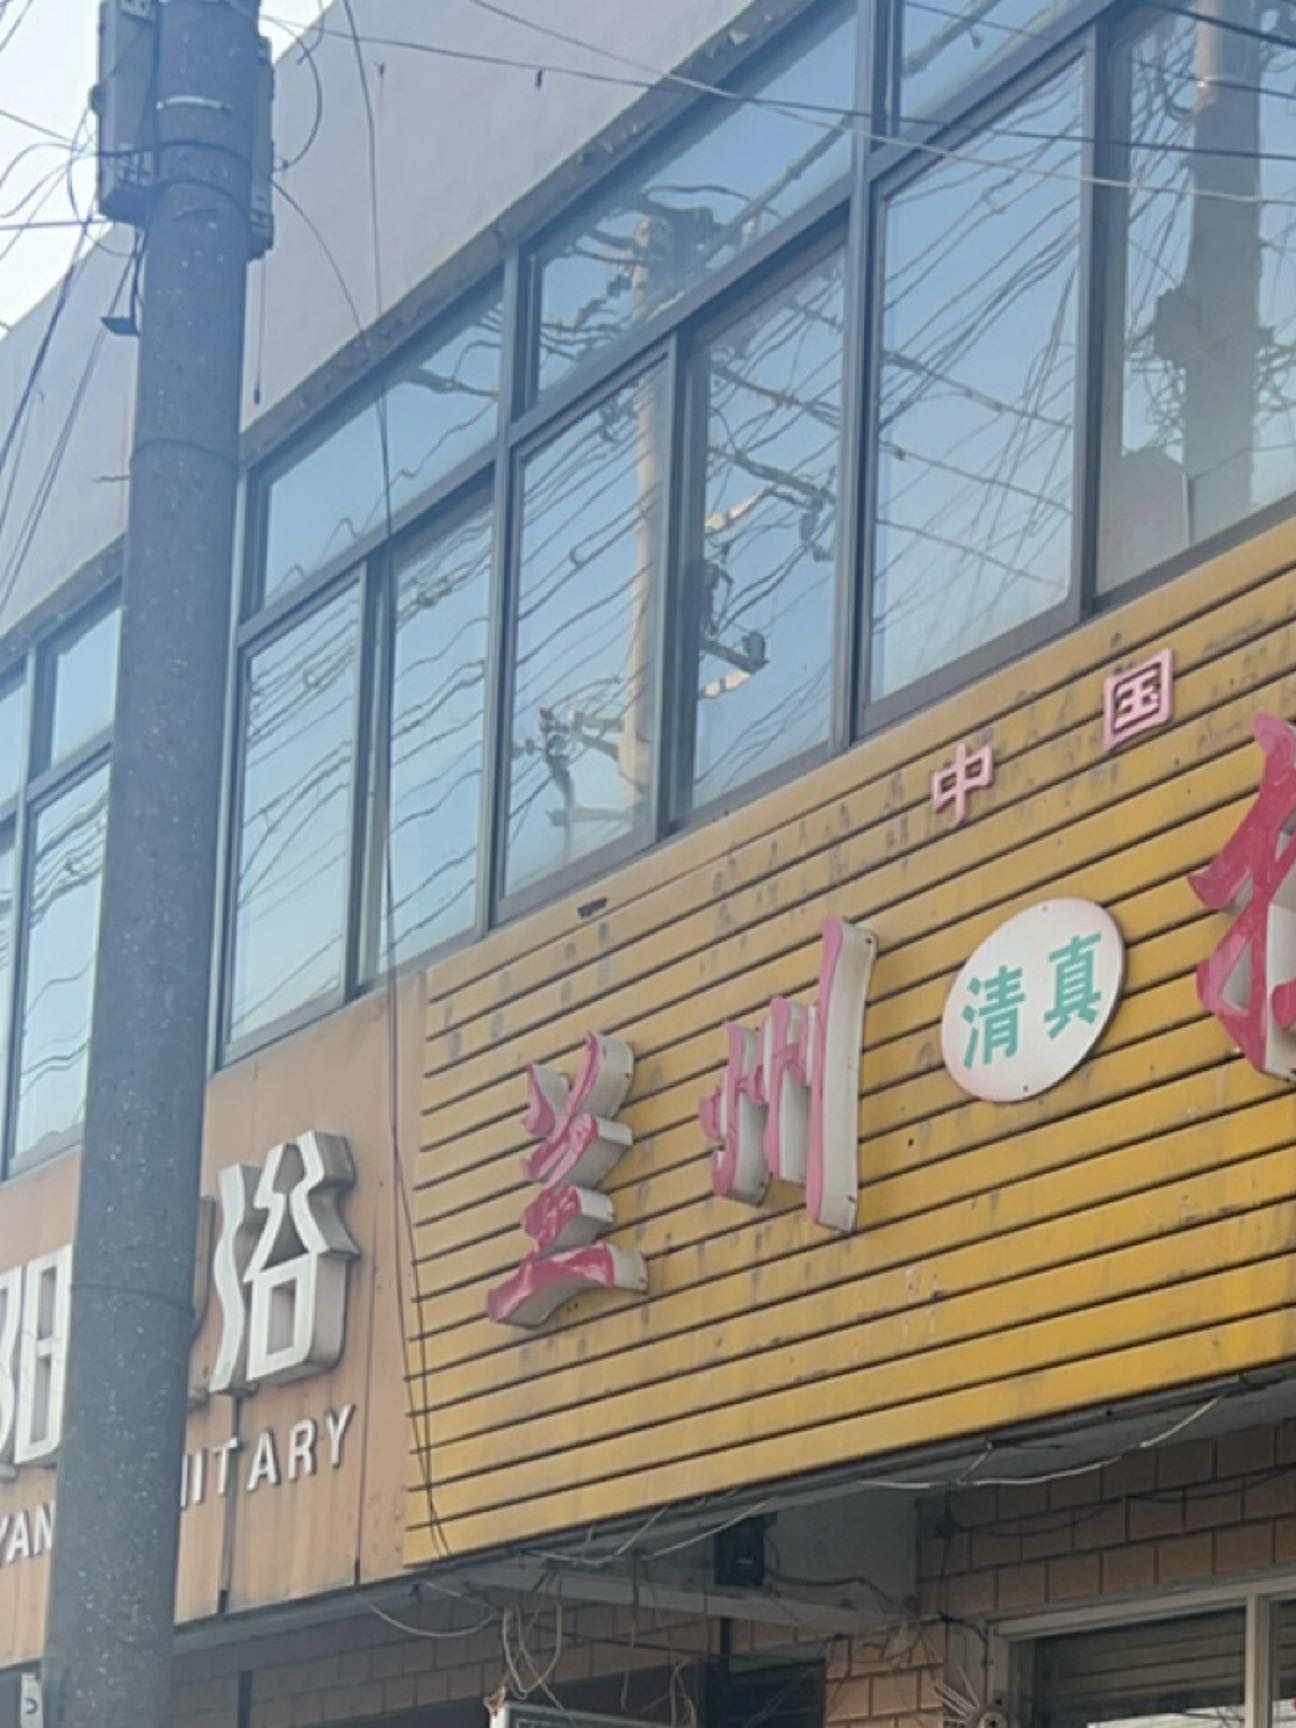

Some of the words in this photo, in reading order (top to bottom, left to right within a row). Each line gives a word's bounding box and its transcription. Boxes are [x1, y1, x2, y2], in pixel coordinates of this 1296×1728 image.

[930, 648, 1174, 823] 中国
[961, 930, 1105, 1070] 清真
[487, 916, 878, 1330] 兰州
[180, 1403, 355, 1508] ITARY
